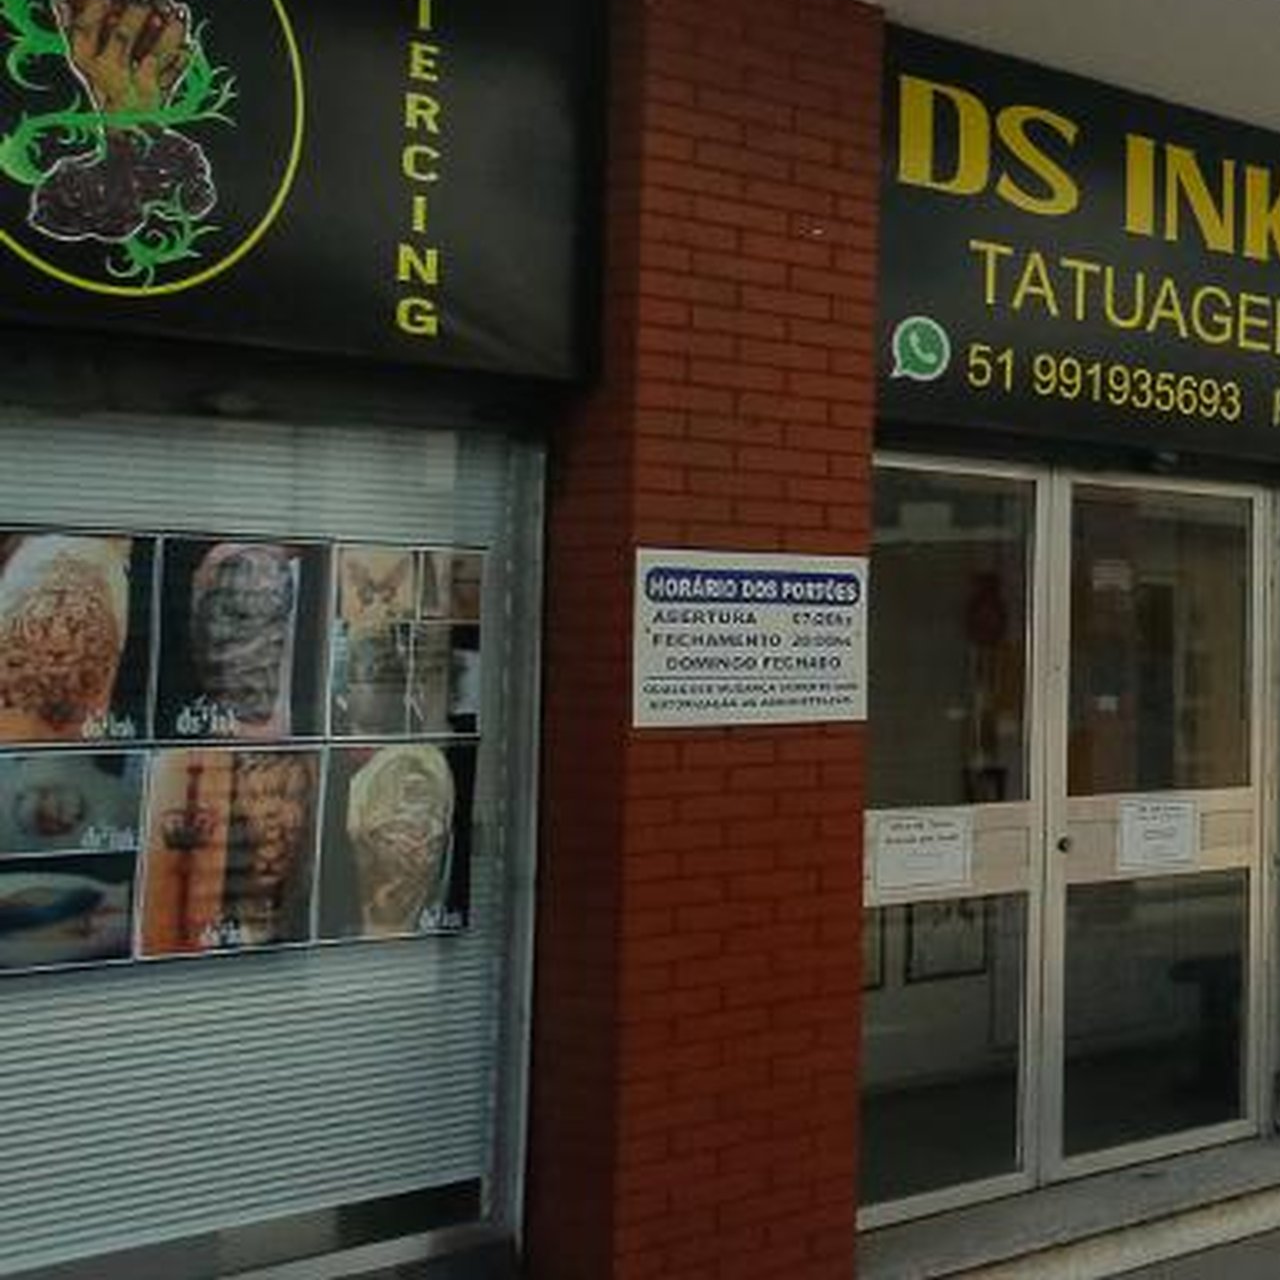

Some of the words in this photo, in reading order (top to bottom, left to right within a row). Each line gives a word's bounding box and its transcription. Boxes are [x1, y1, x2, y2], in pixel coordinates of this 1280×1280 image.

[897, 74, 1082, 216] DS
[967, 342, 1016, 393] 51
[1033, 352, 1242, 421] 991935693
[650, 571, 738, 597] HORÁRIO
[741, 579, 778, 599] DOS
[652, 609, 758, 625] ABERTURA
[653, 633, 782, 648] FECHAMENTO
